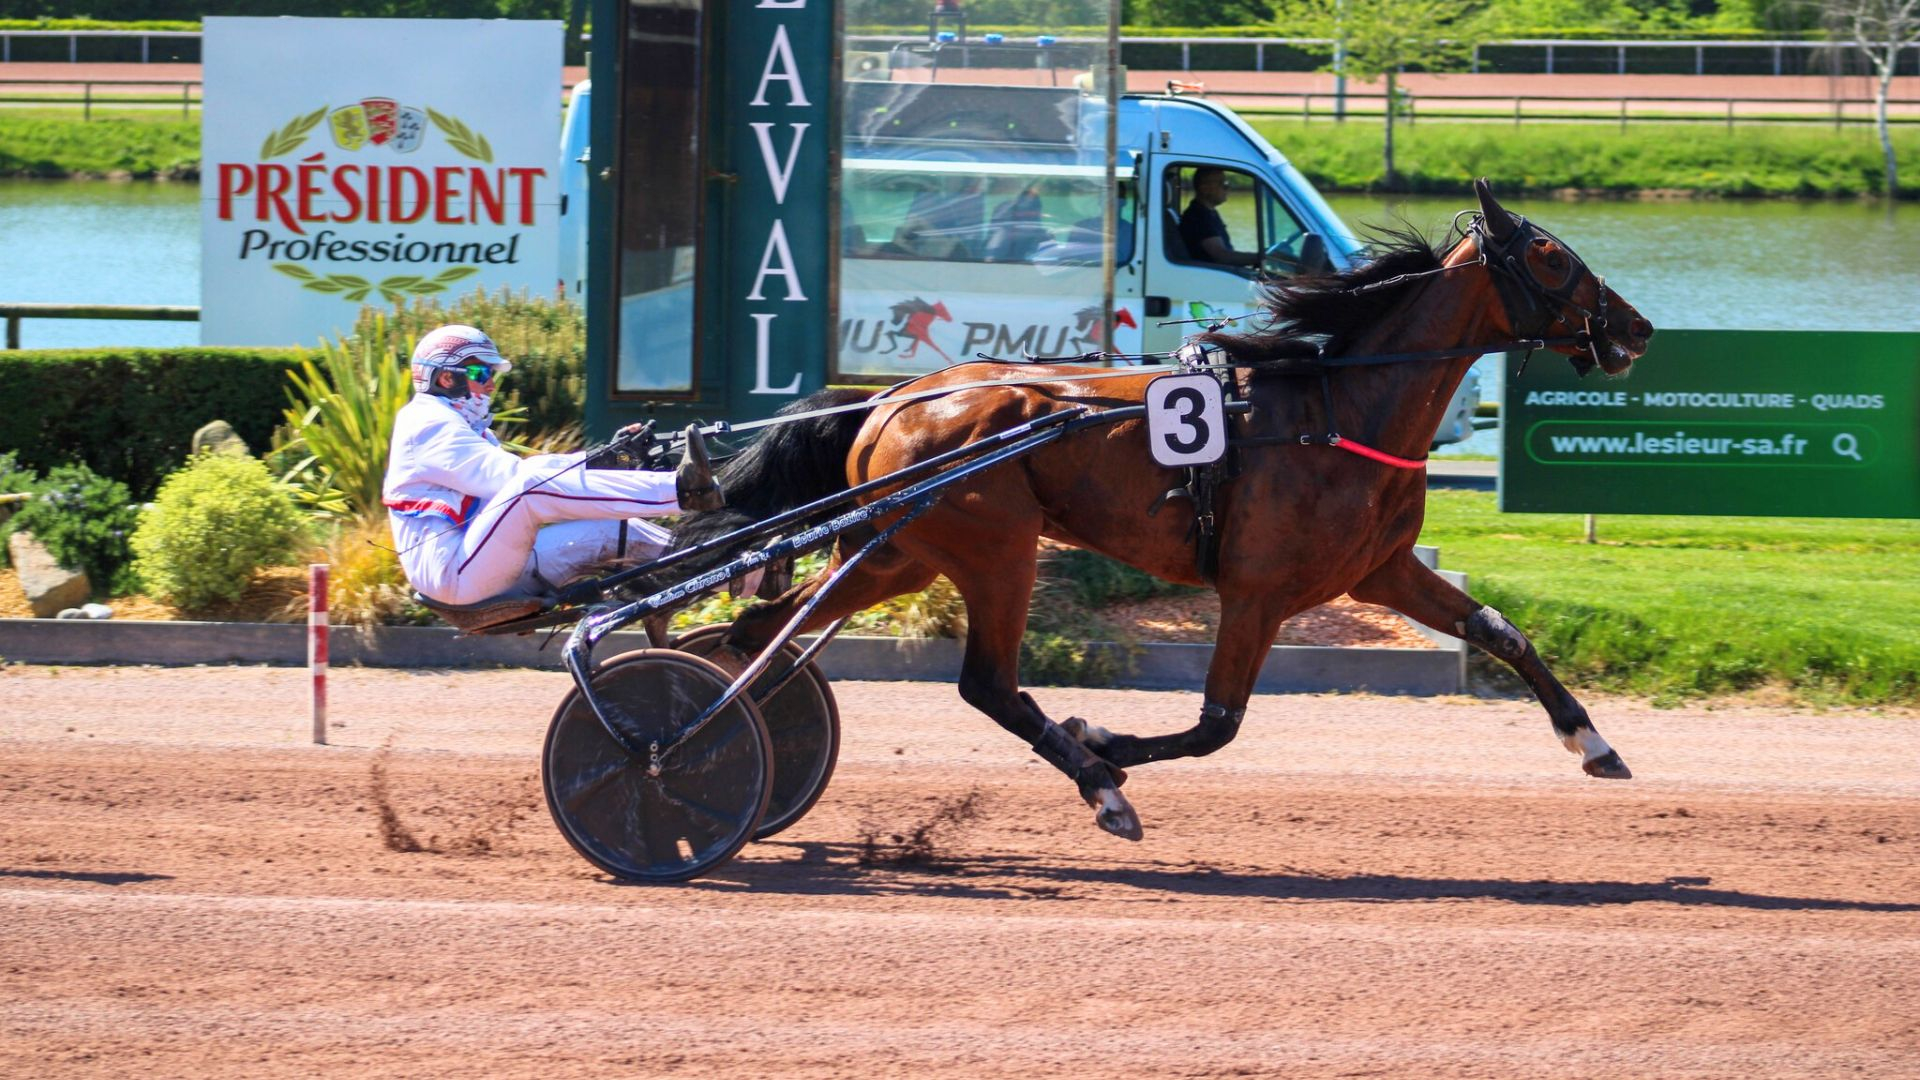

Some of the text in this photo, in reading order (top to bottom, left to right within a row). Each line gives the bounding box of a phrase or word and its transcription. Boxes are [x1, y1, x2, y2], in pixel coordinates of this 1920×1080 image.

[217, 152, 547, 235] PRÉSIDENT
[746, 0, 812, 394] AVAL
[238, 229, 520, 264] Professionnel
[960, 322, 1070, 358] PMU
[1525, 391, 1628, 406] AGRICOLE
[1643, 392, 1795, 408] MOTOCULTURE
[1811, 393, 1885, 411] QUADS
[1163, 387, 1211, 455] 3
[1551, 431, 1808, 456] www.lesieur-sa.fr
